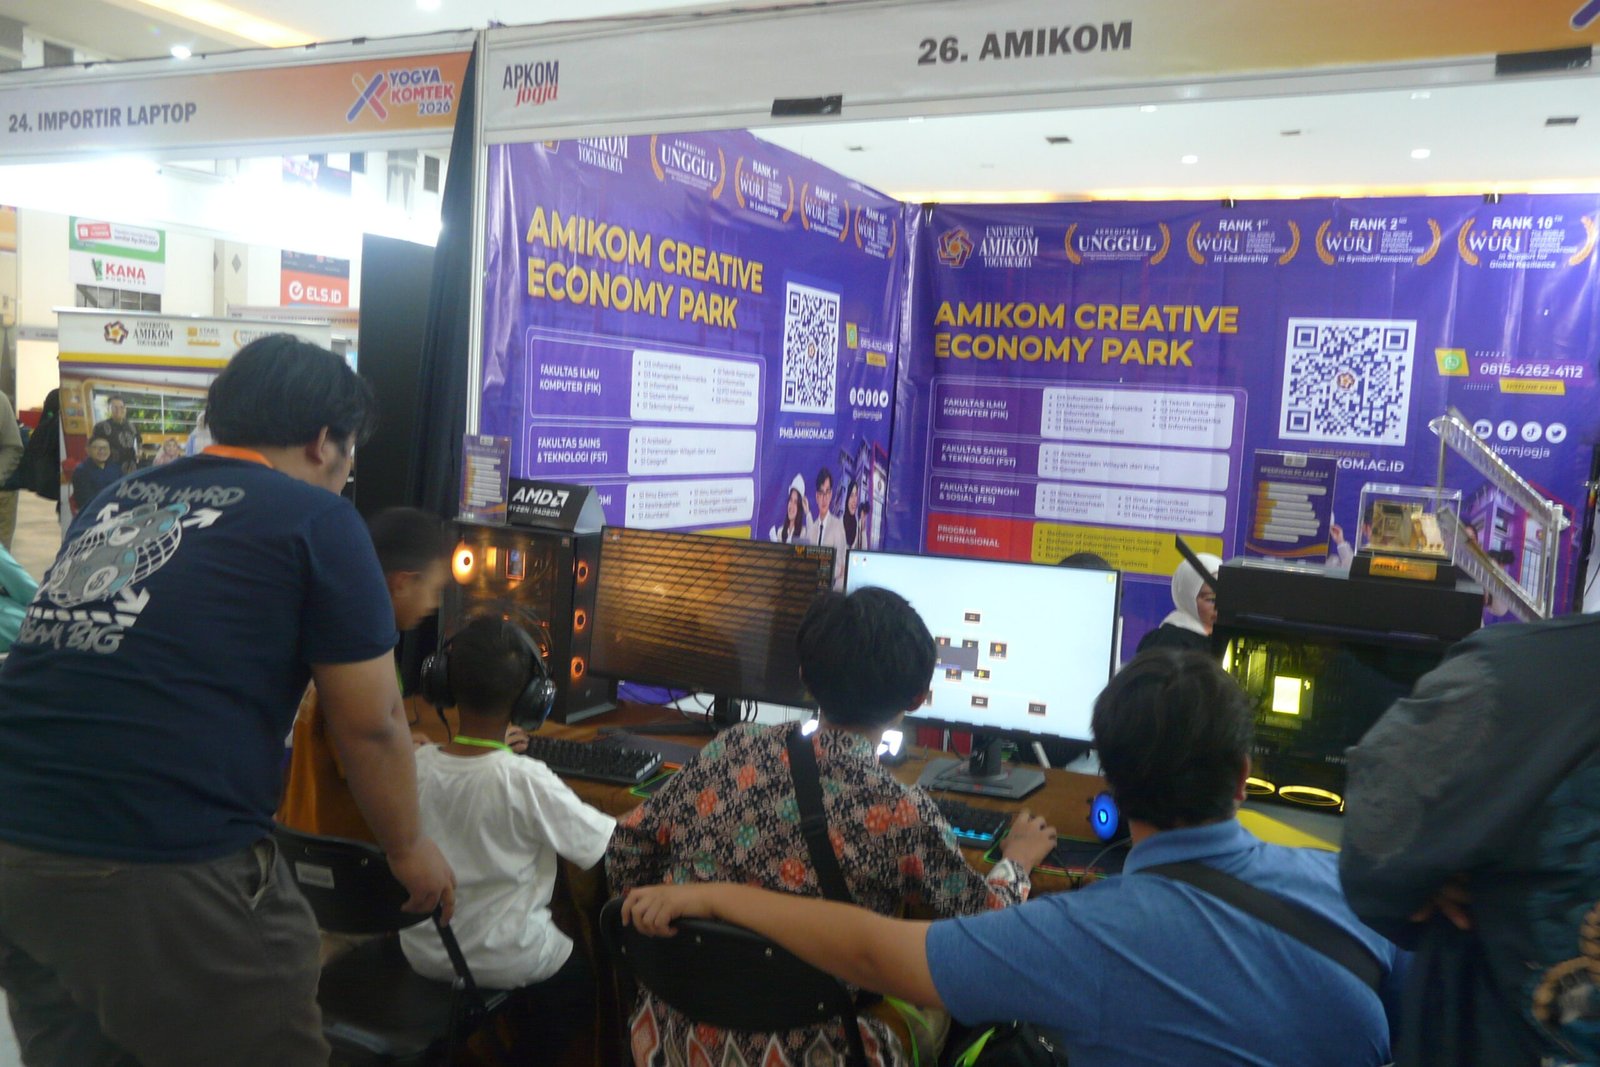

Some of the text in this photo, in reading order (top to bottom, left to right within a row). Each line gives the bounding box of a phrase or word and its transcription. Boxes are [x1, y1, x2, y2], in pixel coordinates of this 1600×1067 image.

[918, 20, 1132, 65] 26. AMIKOM
[389, 69, 441, 85] YOGYA
[503, 61, 559, 89] APKOM
[391, 85, 454, 102] KOMTEK
[516, 81, 558, 107] jogja
[418, 102, 450, 114] 2026
[9, 102, 197, 133] 24. IMPORTIR LAPTOP
[578, 144, 623, 174] YOGYAKARTA
[661, 144, 717, 182] UNGGUL
[753, 160, 772, 178] RANK
[1219, 219, 1253, 232] RANK
[1350, 217, 1386, 230] RANK
[1492, 216, 1533, 230] RANK
[986, 225, 1034, 238] UNIVERSITAS
[526, 206, 764, 294] AMIKOM CREATIVE
[979, 236, 1039, 257] AMIKOM
[1078, 235, 1156, 251] UNGGUL
[984, 257, 1032, 268] YOGYAKARTA
[1224, 254, 1268, 264] Leadership
[106, 263, 146, 280] KANA
[307, 286, 341, 304] ELS.ID
[527, 256, 738, 329] ECONOMY PARK
[934, 301, 1239, 334] AMIKOM CREATIVE
[133, 328, 173, 341] AMIKOM
[934, 333, 1194, 367] ECONOMY PARK
[540, 364, 600, 380] FAKULTAS ILMU
[1480, 362, 1583, 378] 0815-4262-4112
[539, 379, 602, 396] KOMPUTER (FIK)
[943, 397, 1007, 409] FAKULTAS ILMU
[943, 407, 989, 418] KOMPUTER
[538, 437, 601, 449] FAKULTAS SAINS
[942, 443, 1008, 455] FAKULTAS SAINS
[543, 451, 588, 463] TEKNOLOGI
[590, 452, 608, 465] (FST)
[947, 454, 994, 465] TEKNOLOGI
[1491, 444, 1550, 460] ikomjogja
[1337, 457, 1405, 472] KOM.AC.ID
[116, 479, 169, 502] WORK
[512, 487, 552, 506] AMD
[940, 482, 1020, 497] FAKULTAS EKONOMI
[946, 492, 973, 503] SOSIAL
[938, 524, 976, 535] PROGRAM
[937, 535, 1000, 548] INTERNASIONAL
[66, 619, 125, 654] BIG
